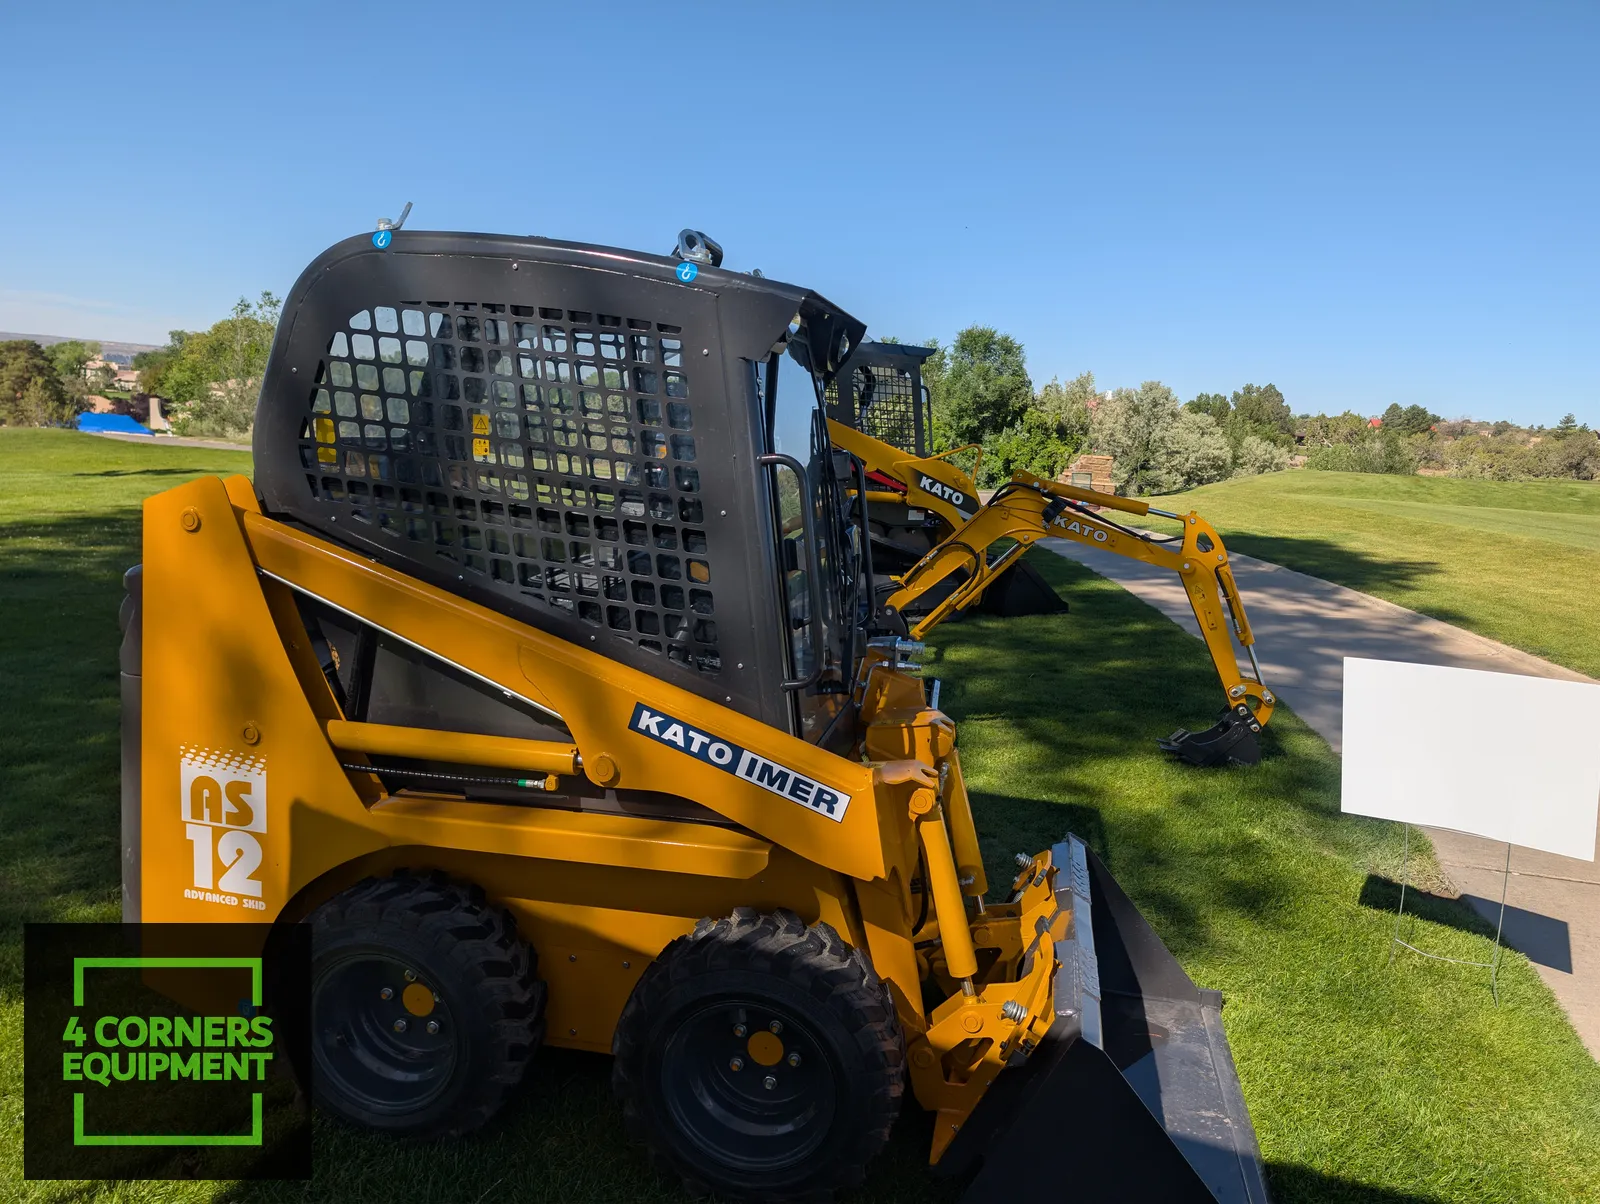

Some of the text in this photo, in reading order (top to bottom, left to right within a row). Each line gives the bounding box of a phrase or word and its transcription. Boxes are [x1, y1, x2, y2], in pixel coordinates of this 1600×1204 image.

[919, 475, 964, 505] KATO
[1053, 514, 1108, 542] KATO
[637, 709, 839, 815] KATO IMER
[190, 775, 254, 827] AS
[186, 823, 263, 898] 12
[184, 889, 266, 911] ADVANCED SKID
